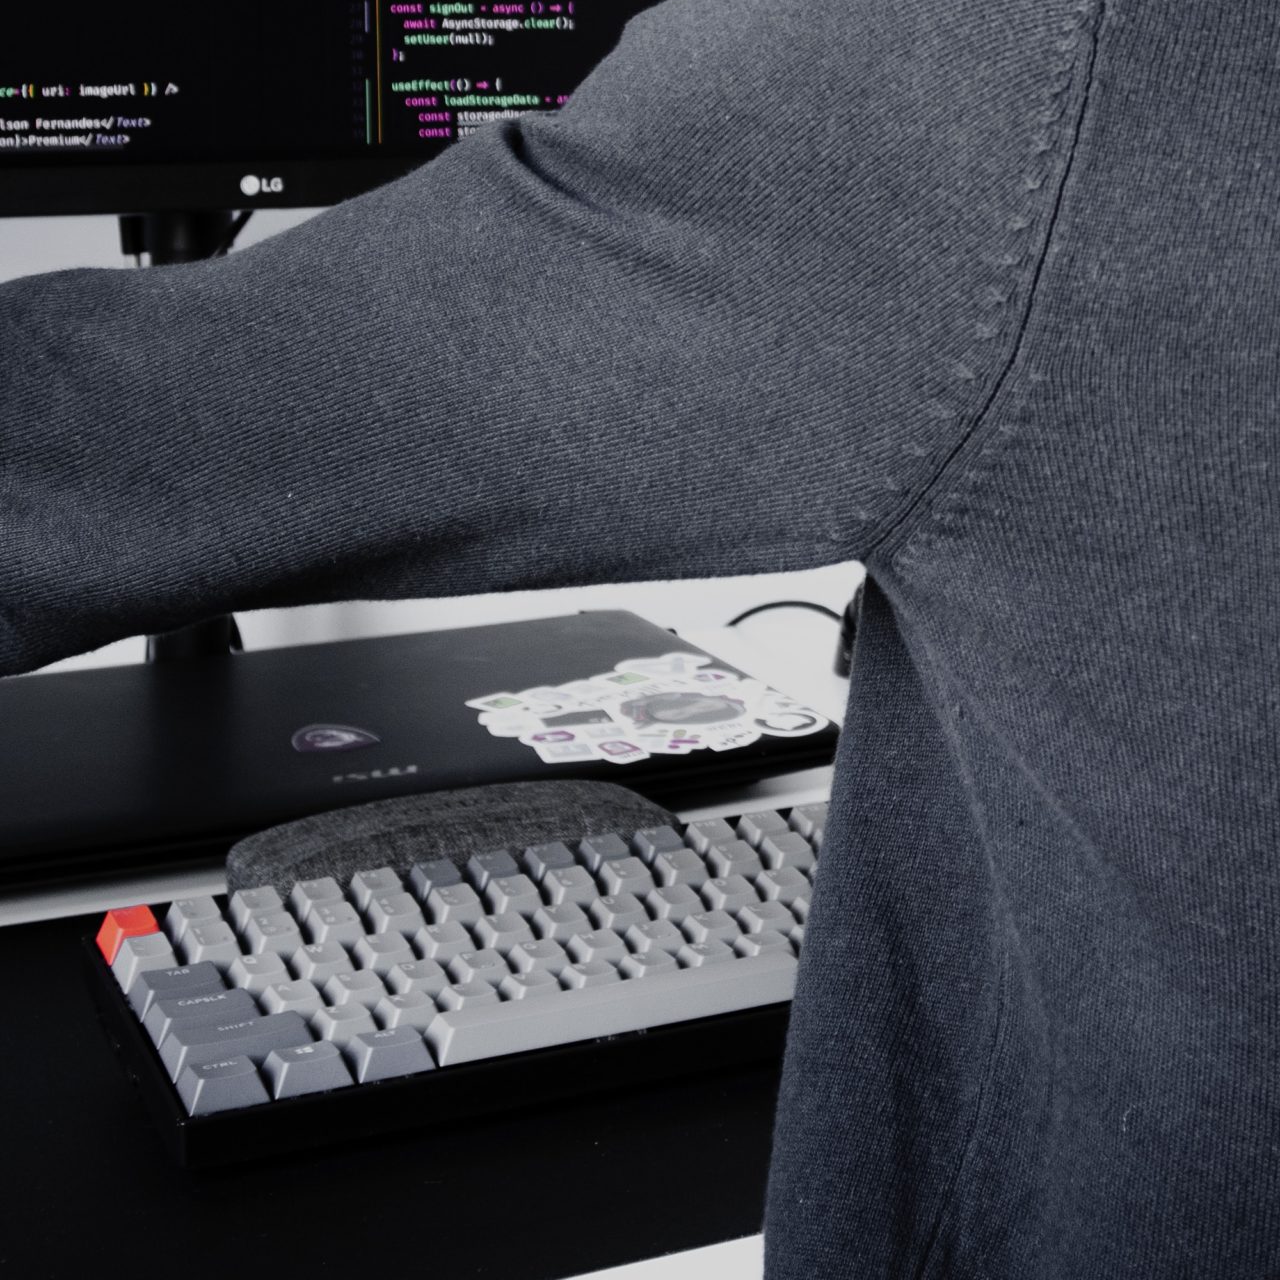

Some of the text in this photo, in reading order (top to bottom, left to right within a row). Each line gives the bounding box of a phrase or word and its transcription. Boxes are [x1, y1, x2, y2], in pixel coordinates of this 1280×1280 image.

[390, 3, 423, 14] const
[429, 1, 474, 17] signOut
[492, 3, 525, 15] async
[403, 16, 575, 32] await AsyncStorage.clear();
[403, 31, 494, 46] setUser(null);
[391, 78, 471, 92] useEffect(()
[404, 96, 438, 107] const
[444, 93, 541, 108] loadStorageData
[418, 111, 451, 122] const
[418, 127, 451, 138] const
[260, 177, 284, 193] LG
[216, 1019, 257, 1033] SHIFT
[373, 1029, 397, 1039] ALT
[201, 1058, 239, 1071] CTRL
